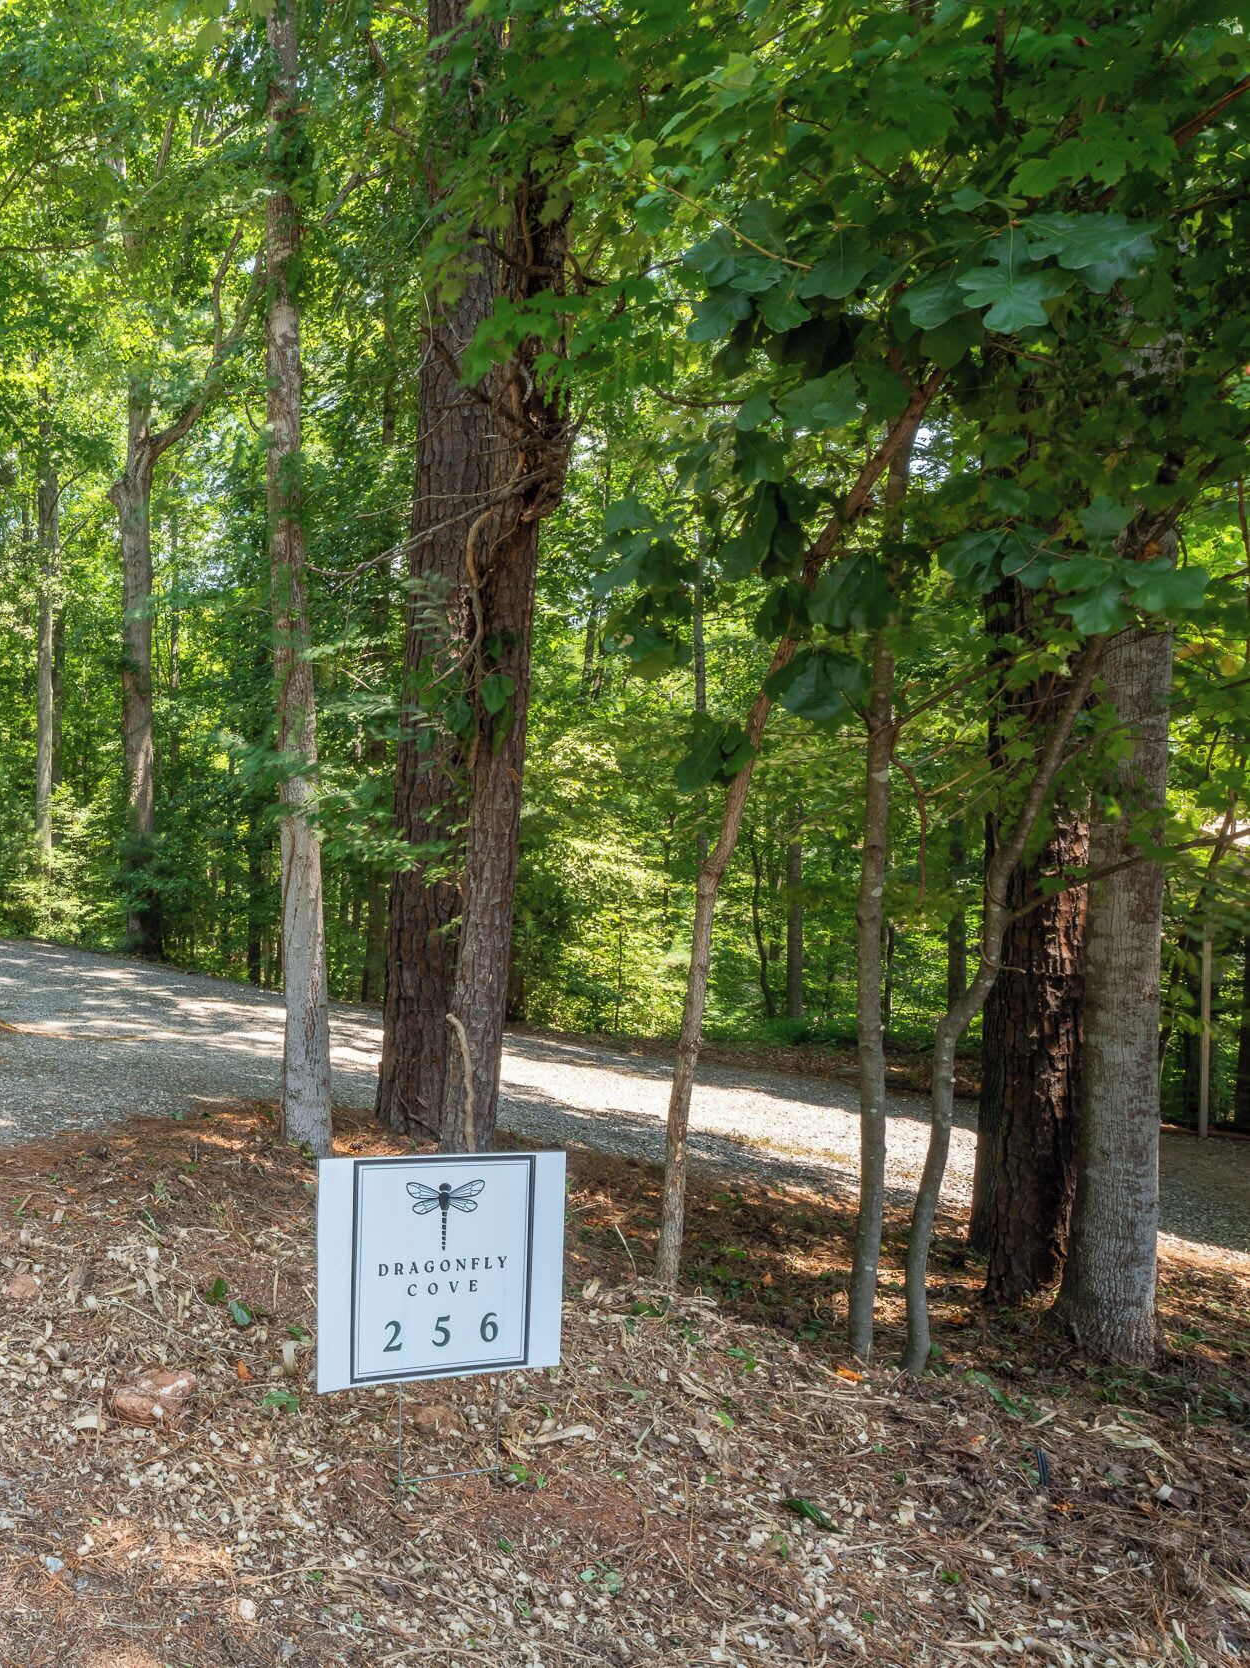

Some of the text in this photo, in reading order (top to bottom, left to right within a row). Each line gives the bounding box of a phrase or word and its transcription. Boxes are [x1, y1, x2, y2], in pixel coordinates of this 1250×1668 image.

[378, 1256, 507, 1276] DRAGONFLY
[407, 1280, 478, 1297] COVE
[382, 1312, 499, 1353] 256
